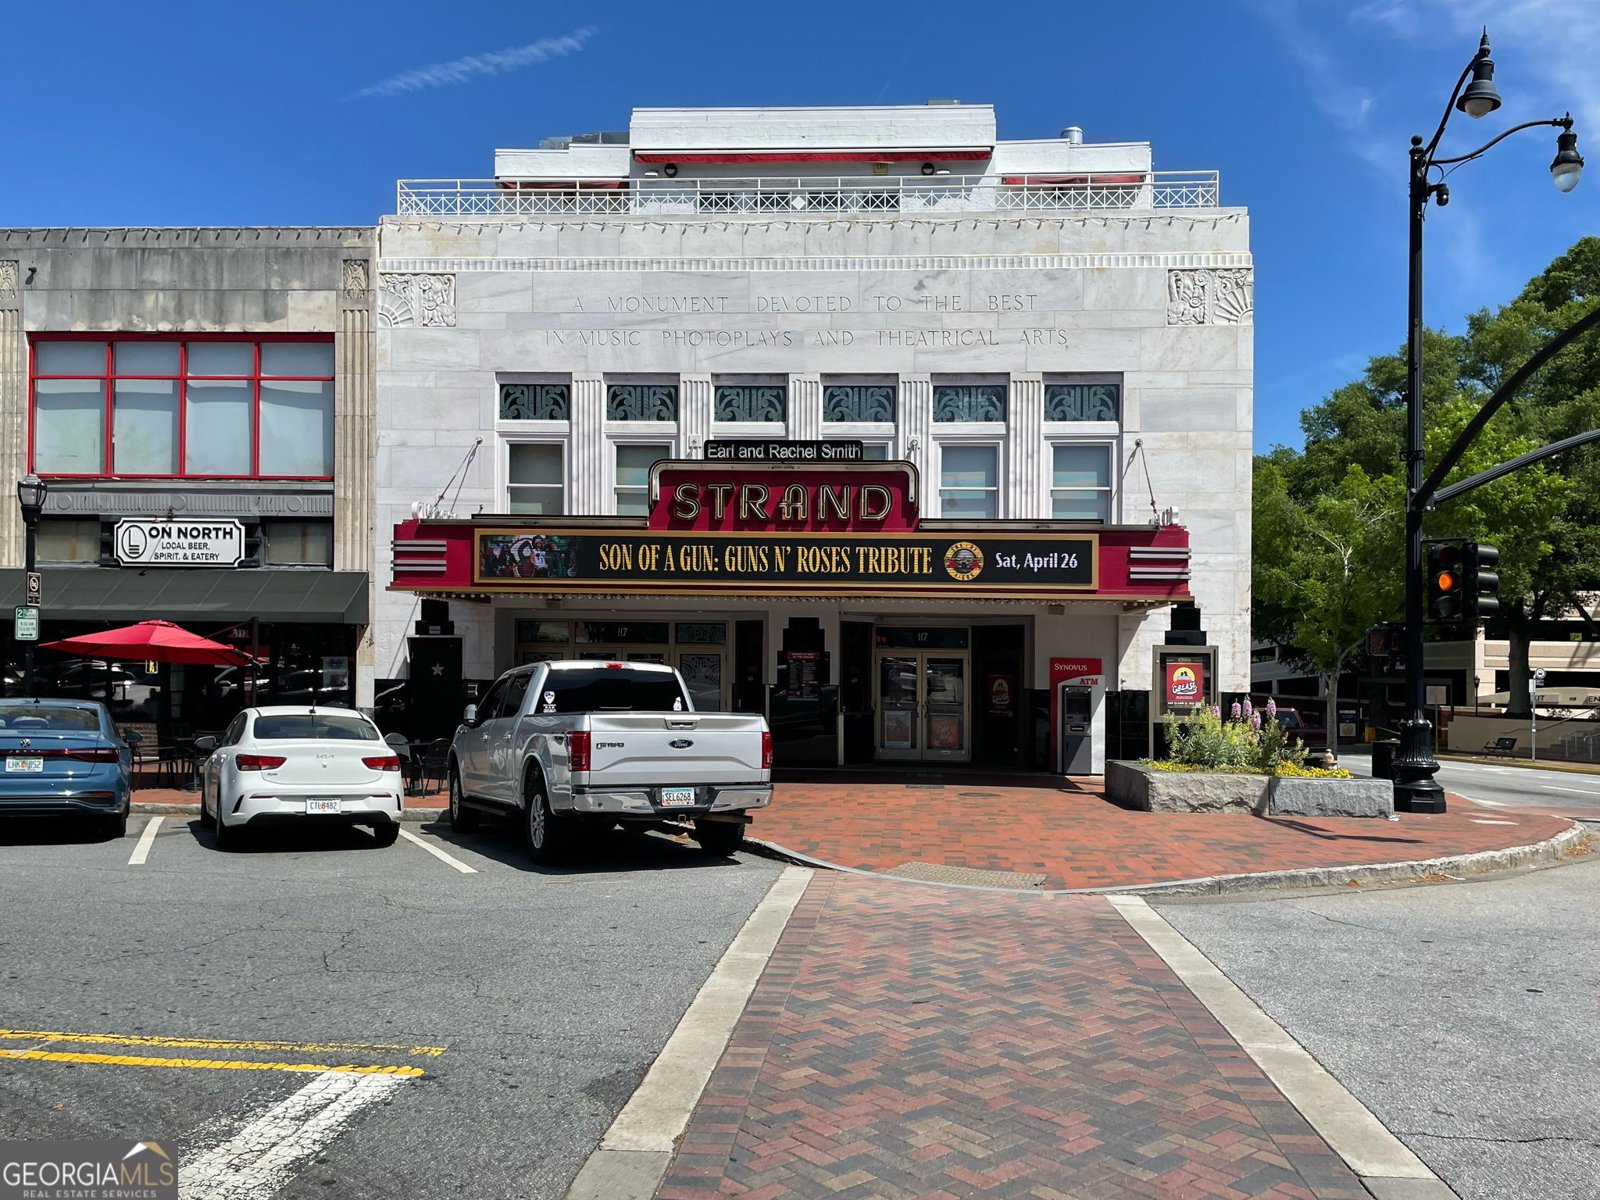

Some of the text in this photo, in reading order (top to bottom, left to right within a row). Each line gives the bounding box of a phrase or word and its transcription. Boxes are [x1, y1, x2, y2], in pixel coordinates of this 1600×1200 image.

[573, 294, 1038, 312] A MONUMENT DEVOTED TO THE BEST
[545, 329, 1068, 347] IN MUSIC PHOTOPLAYS AND THEATRICAL ARTS
[707, 443, 861, 459] Earl and Rachel Smith
[673, 482, 893, 521] STRAND
[148, 526, 233, 540] ON NORTH
[161, 541, 186, 550] LOCAL
[182, 552, 189, 560] &
[191, 552, 220, 561] EATERY
[599, 543, 633, 571] SON
[638, 544, 660, 572] OF
[664, 544, 676, 572] A
[680, 544, 720, 572] GUN:
[724, 545, 769, 573] GUNS
[796, 545, 850, 574] ROSES
[856, 546, 933, 574] TRIBUTE
[995, 552, 1078, 573] Sat, April 26
[617, 627, 628, 637] 117
